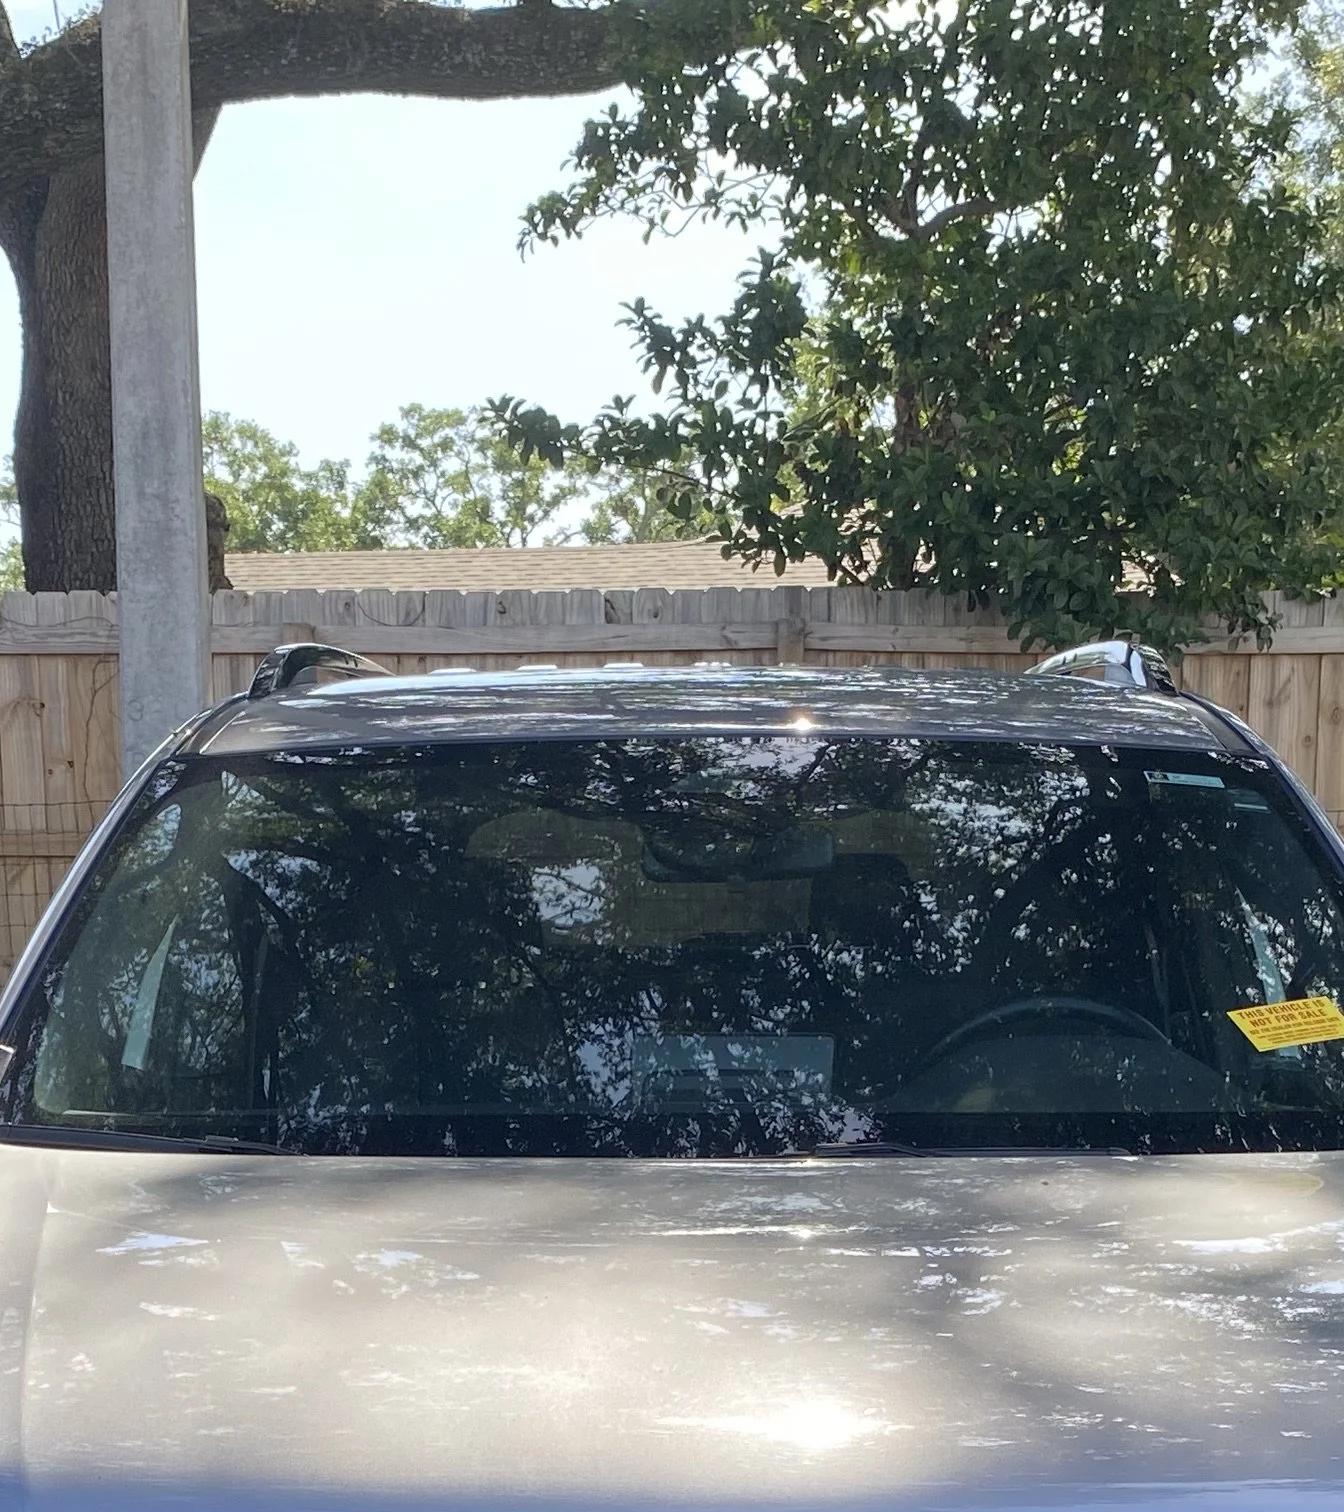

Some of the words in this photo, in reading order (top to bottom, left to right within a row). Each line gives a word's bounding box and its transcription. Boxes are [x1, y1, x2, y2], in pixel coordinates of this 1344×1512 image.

[1237, 1008, 1265, 1020] THIS
[1266, 1001, 1313, 1016] VEHICLE
[1314, 999, 1326, 1009] IS
[1249, 1016, 1274, 1028] NOT
[1275, 1012, 1297, 1024] FOR
[1299, 1008, 1327, 1020] SALE
